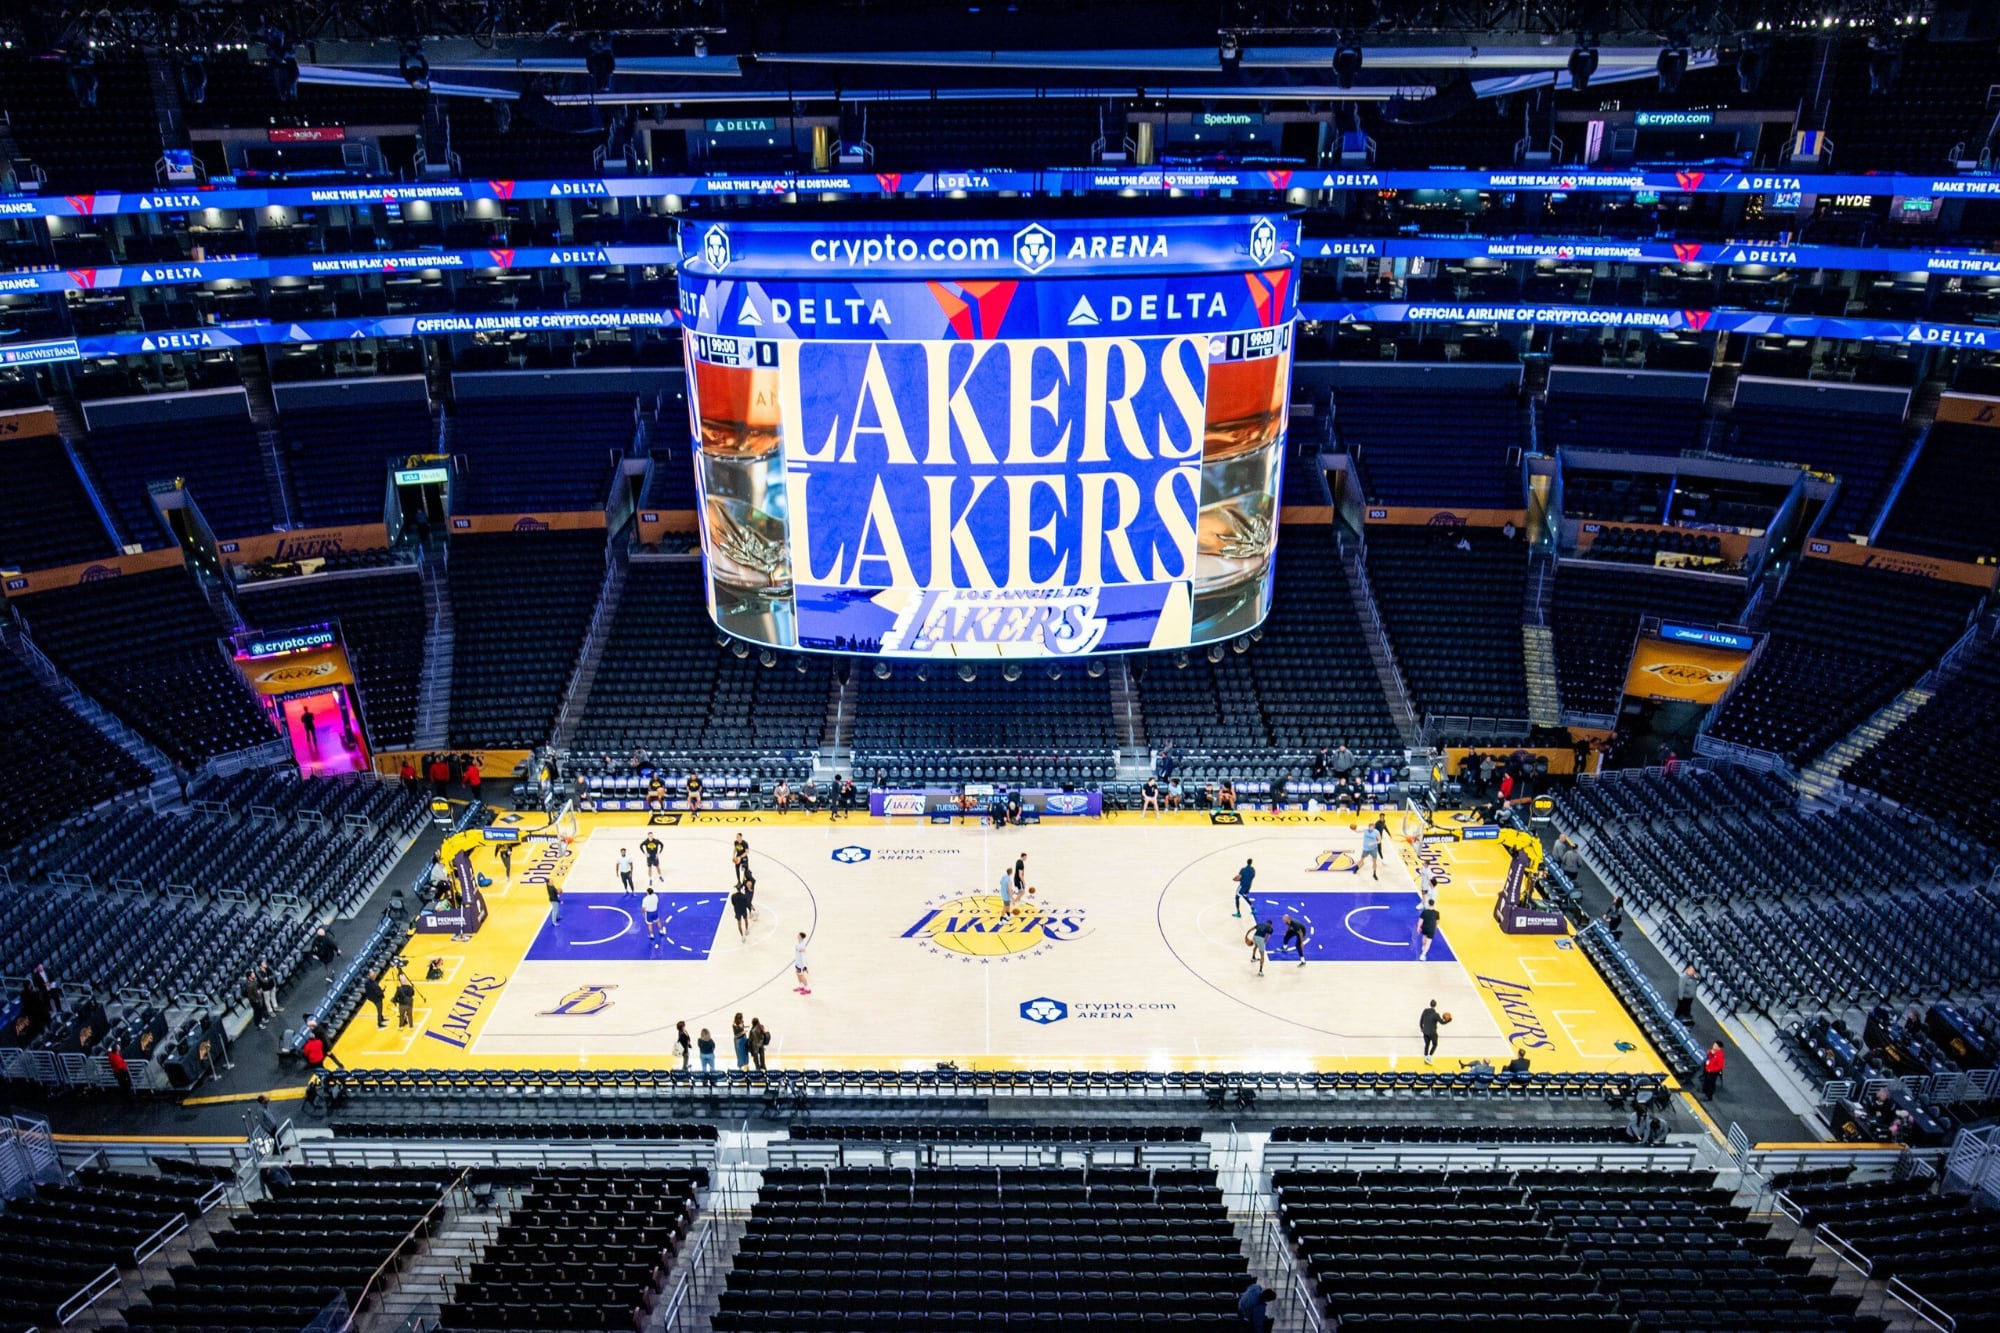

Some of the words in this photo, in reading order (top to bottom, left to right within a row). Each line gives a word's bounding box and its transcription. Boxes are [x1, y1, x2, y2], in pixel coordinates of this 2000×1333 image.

[728, 120, 766, 130] DELTA
[1204, 113, 1249, 125] Spectrum
[1649, 112, 1710, 125] crypto.com
[707, 181, 733, 190] MAKE
[733, 181, 750, 190] THE
[751, 180, 773, 190] PLAY.
[806, 179, 850, 188] DISTANCE.
[948, 177, 989, 187] DELTA
[1095, 176, 1120, 185] MAKE
[1121, 176, 1137, 185] THE
[1138, 176, 1160, 185] PLAY.
[1177, 175, 1193, 184] THE
[1194, 175, 1238, 185] DISTANCE.
[1336, 175, 1378, 185] DELTA
[1490, 176, 1517, 185] MAKE
[1518, 176, 1536, 185] THE
[1536, 176, 1559, 185] PLAY.
[1578, 176, 1596, 185] THE
[1596, 176, 1645, 186] DISTANCE.
[1753, 178, 1800, 189] DELTA
[1932, 181, 1965, 192] MAKE
[1966, 182, 1987, 192] THE
[312, 191, 338, 200] MAKE
[339, 191, 358, 200] THE
[358, 190, 382, 199] PLAY.
[399, 188, 416, 198] THE
[417, 187, 463, 197] DISTANCE.
[564, 183, 605, 194] DELTA
[153, 195, 200, 208] DELTA
[1835, 195, 1872, 206] HYDE
[0, 202, 37, 214] TANCE.
[810, 234, 999, 266] crypto.com
[1067, 234, 1168, 260] ARENA
[1334, 244, 1375, 254] DELTA
[1488, 245, 1515, 255] MAKE
[1516, 245, 1534, 255] THE
[1534, 245, 1557, 255] PLAY.
[1575, 245, 1593, 255] THE
[1594, 246, 1642, 257] DISTANCE.
[564, 251, 605, 262] DELTA
[1750, 251, 1797, 263] DELTA
[312, 261, 339, 271] MAKE
[340, 260, 358, 270] THE
[359, 259, 382, 269] PLAY.
[399, 258, 417, 268] THE
[418, 256, 463, 267] DISTANCE.
[1928, 258, 1960, 269] MAKE
[1961, 259, 1981, 270] THE
[155, 267, 201, 280] DELTA
[772, 298, 892, 325] DELTA
[1111, 292, 1227, 321] DELTA
[417, 317, 473, 331] OFFICIAL
[474, 317, 521, 329] AIRLINE
[523, 316, 540, 328] OF
[541, 313, 621, 327] CRYPTO.COM
[622, 312, 663, 325] ARENA
[1408, 307, 1465, 320] OFFICIAL
[1466, 308, 1514, 321] AIRLINE
[1516, 309, 1534, 321] OF
[1536, 309, 1622, 324] CRYPTO.COM
[1624, 312, 1669, 325] ARENA
[158, 333, 212, 348] DELTA
[1250, 330, 1273, 346] 99:00
[1927, 329, 1986, 345] DELTA
[712, 338, 735, 353] 99:00
[1232, 337, 1239, 356] 0
[763, 344, 771, 364] 0
[778, 336, 1209, 464] LAKERS
[787, 465, 1201, 588] LAKERS
[222, 543, 236, 553] 117
[10, 580, 24, 589] 117
[897, 590, 1100, 655] LAKERS
[265, 632, 332, 651] crypto.com
[1709, 634, 1737, 645] ULTRA
[885, 795, 926, 813] LAKERS
[890, 909, 1096, 941] LAKERS
[425, 972, 507, 1049] LAKERS
[1075, 1001, 1177, 1011] crypto.com
[1475, 972, 1556, 1052] LAKERS
